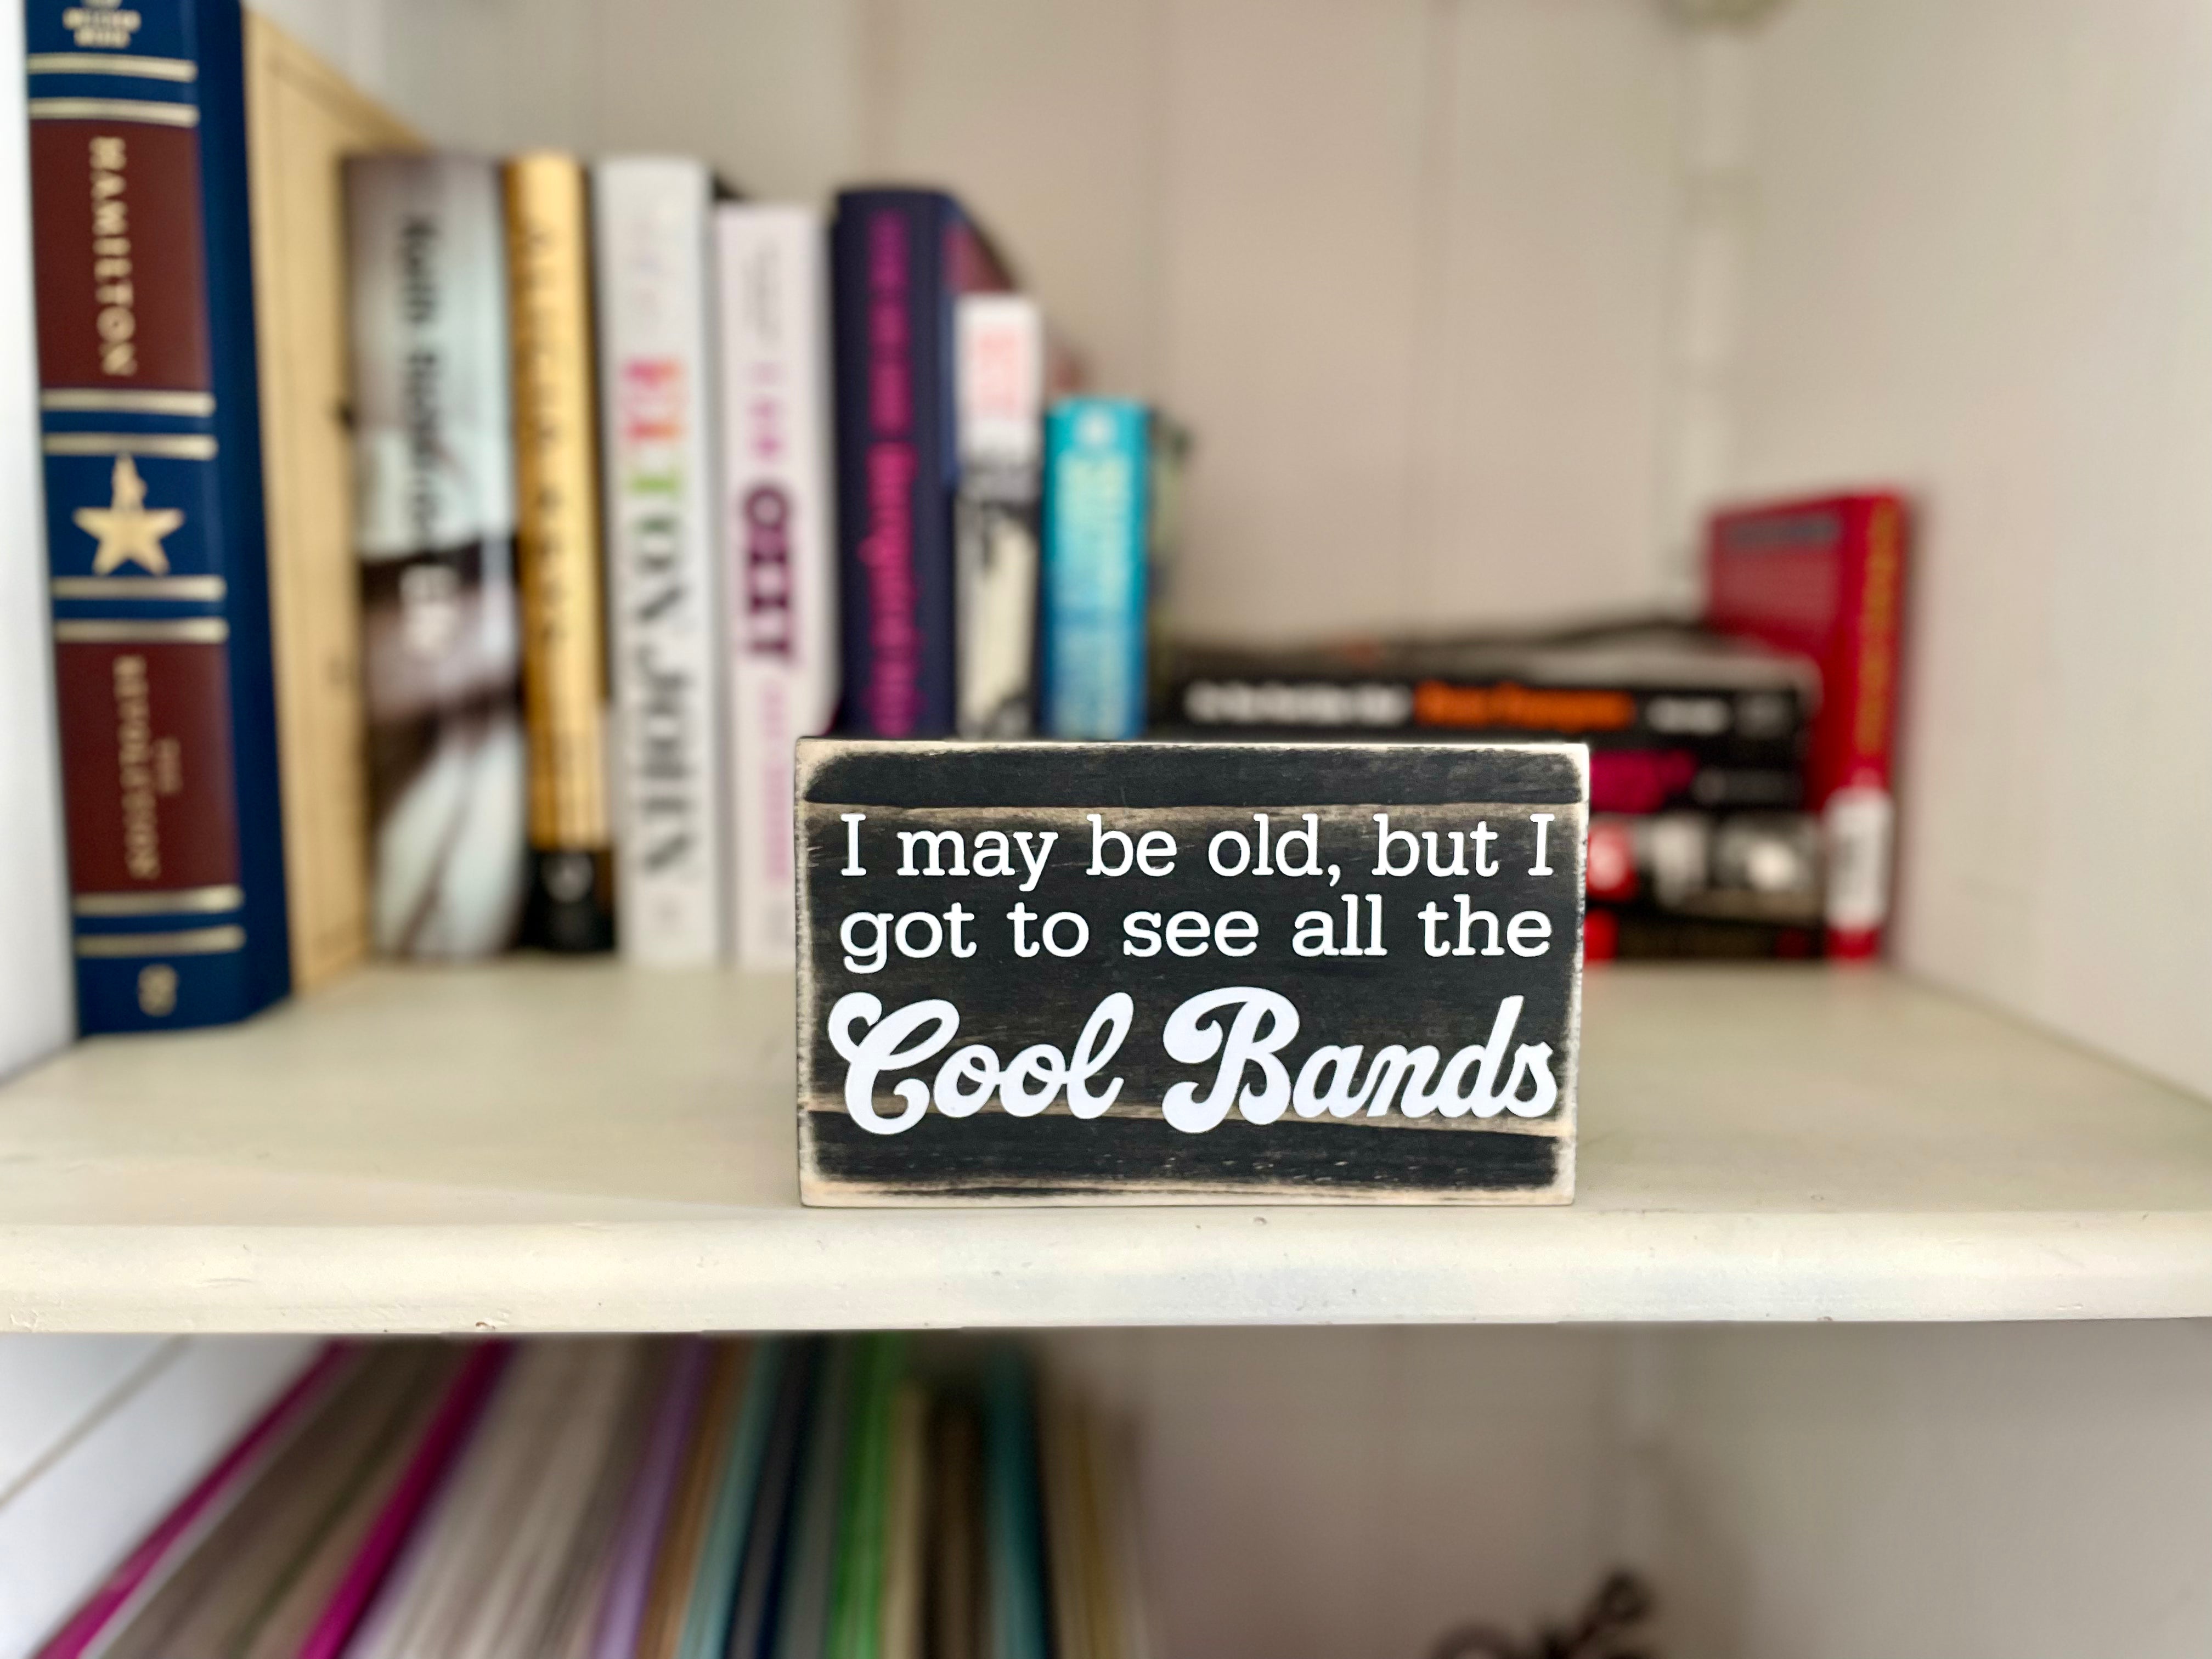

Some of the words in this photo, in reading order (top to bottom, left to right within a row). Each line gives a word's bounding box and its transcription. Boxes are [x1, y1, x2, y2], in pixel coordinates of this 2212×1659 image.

[89, 136, 138, 376] HAMILTON
[623, 357, 687, 624] ELTON
[635, 643, 695, 873] JOHN
[840, 813, 867, 877] I
[896, 830, 1059, 892] may
[1086, 813, 1177, 877] be
[1207, 812, 1342, 889] old,
[1371, 812, 1499, 877] but
[1527, 812, 1556, 877] I
[839, 902, 978, 974] got
[1006, 901, 1090, 958] to
[1122, 910, 1260, 957] see
[1292, 893, 1388, 957] all
[1417, 893, 1552, 958] the
[827, 991, 1135, 1135] Cool
[1161, 986, 1558, 1134] Bands
